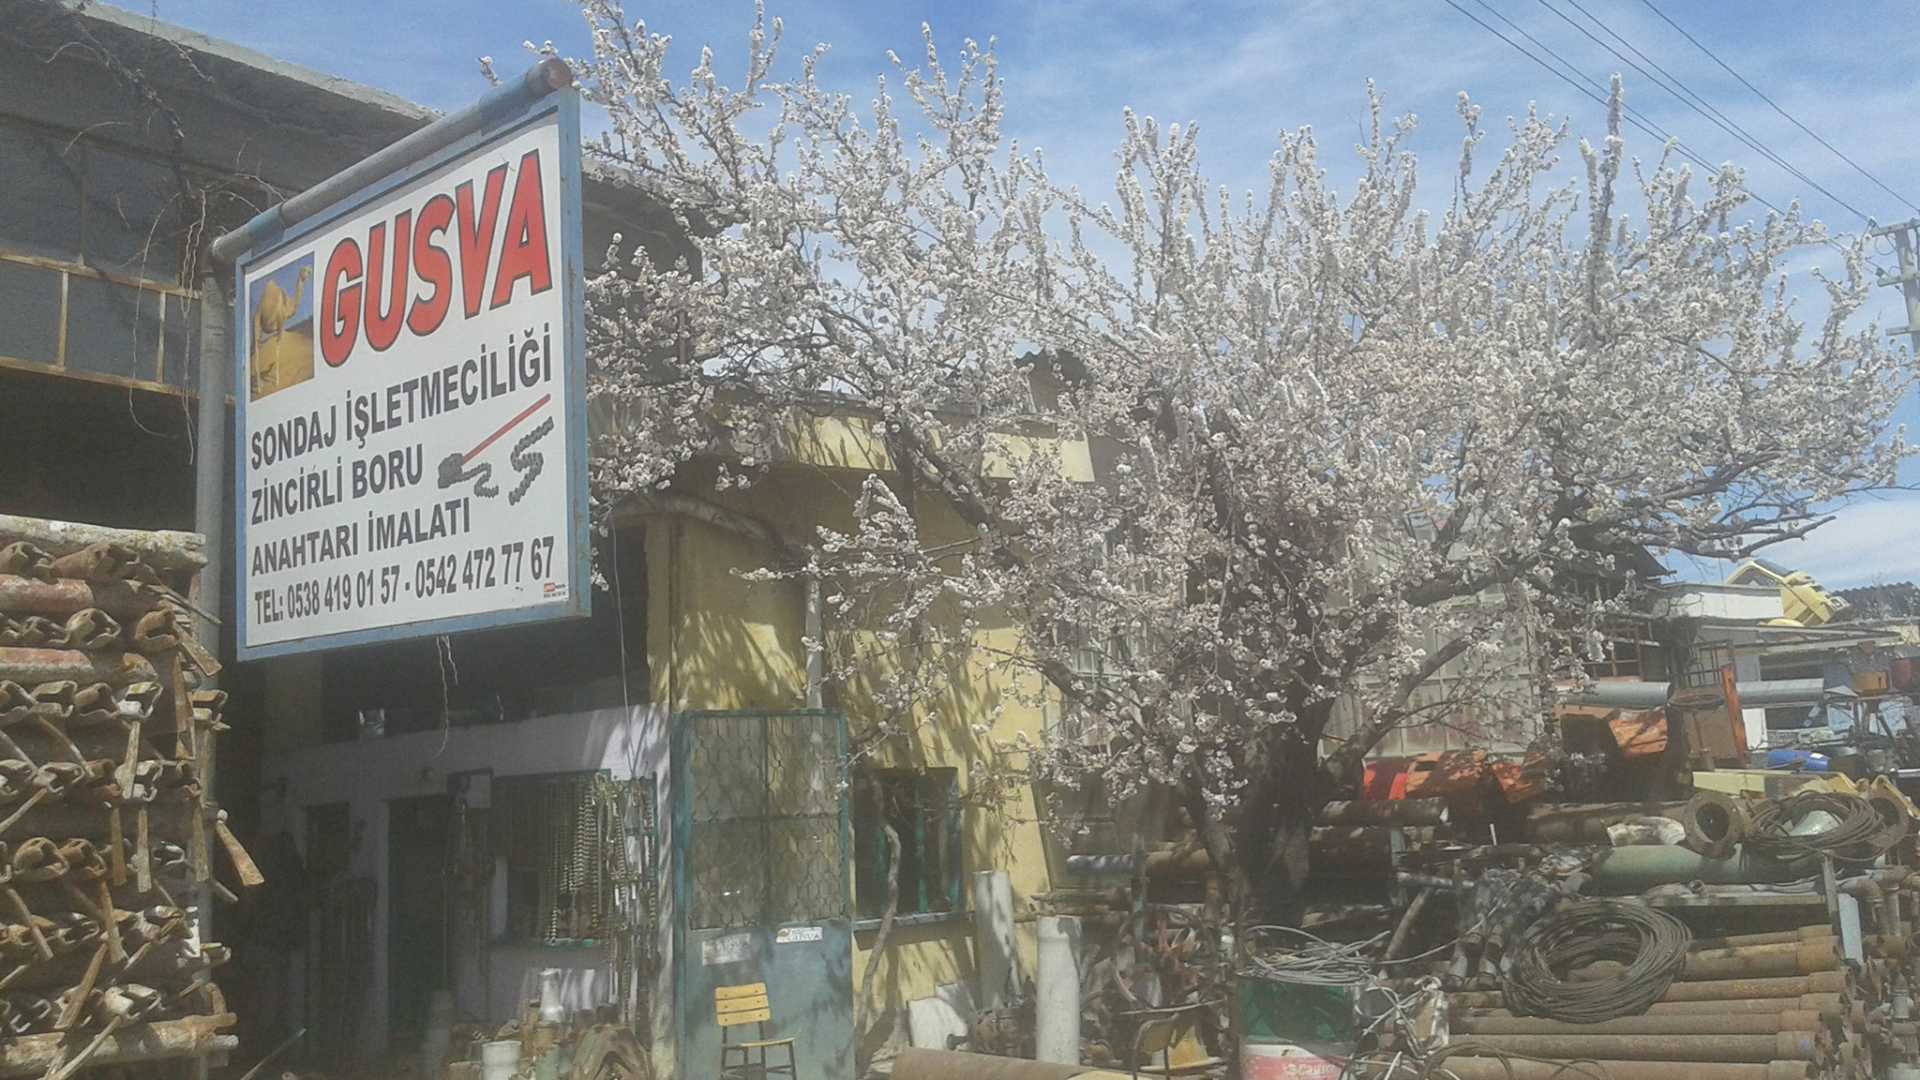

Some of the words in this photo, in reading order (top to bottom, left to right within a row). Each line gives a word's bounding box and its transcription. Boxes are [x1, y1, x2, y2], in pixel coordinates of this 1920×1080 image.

[320, 148, 553, 367] GUSVA
[251, 405, 337, 470] SONDAJ
[346, 322, 551, 449] İŞLETMECİLİĞİ
[251, 456, 343, 525] ZİNCİRLİ
[352, 443, 423, 499] BORU
[252, 522, 358, 576] ANAHTARI
[368, 497, 470, 552] İMALATI
[255, 589, 284, 624] TEL:
[287, 579, 320, 619] 0538
[324, 573, 351, 612] 419
[356, 569, 374, 608] 01
[380, 564, 400, 604] 57
[415, 554, 457, 599] 0542
[462, 547, 496, 590] 472
[501, 541, 524, 585] 77
[530, 536, 554, 580] 67
